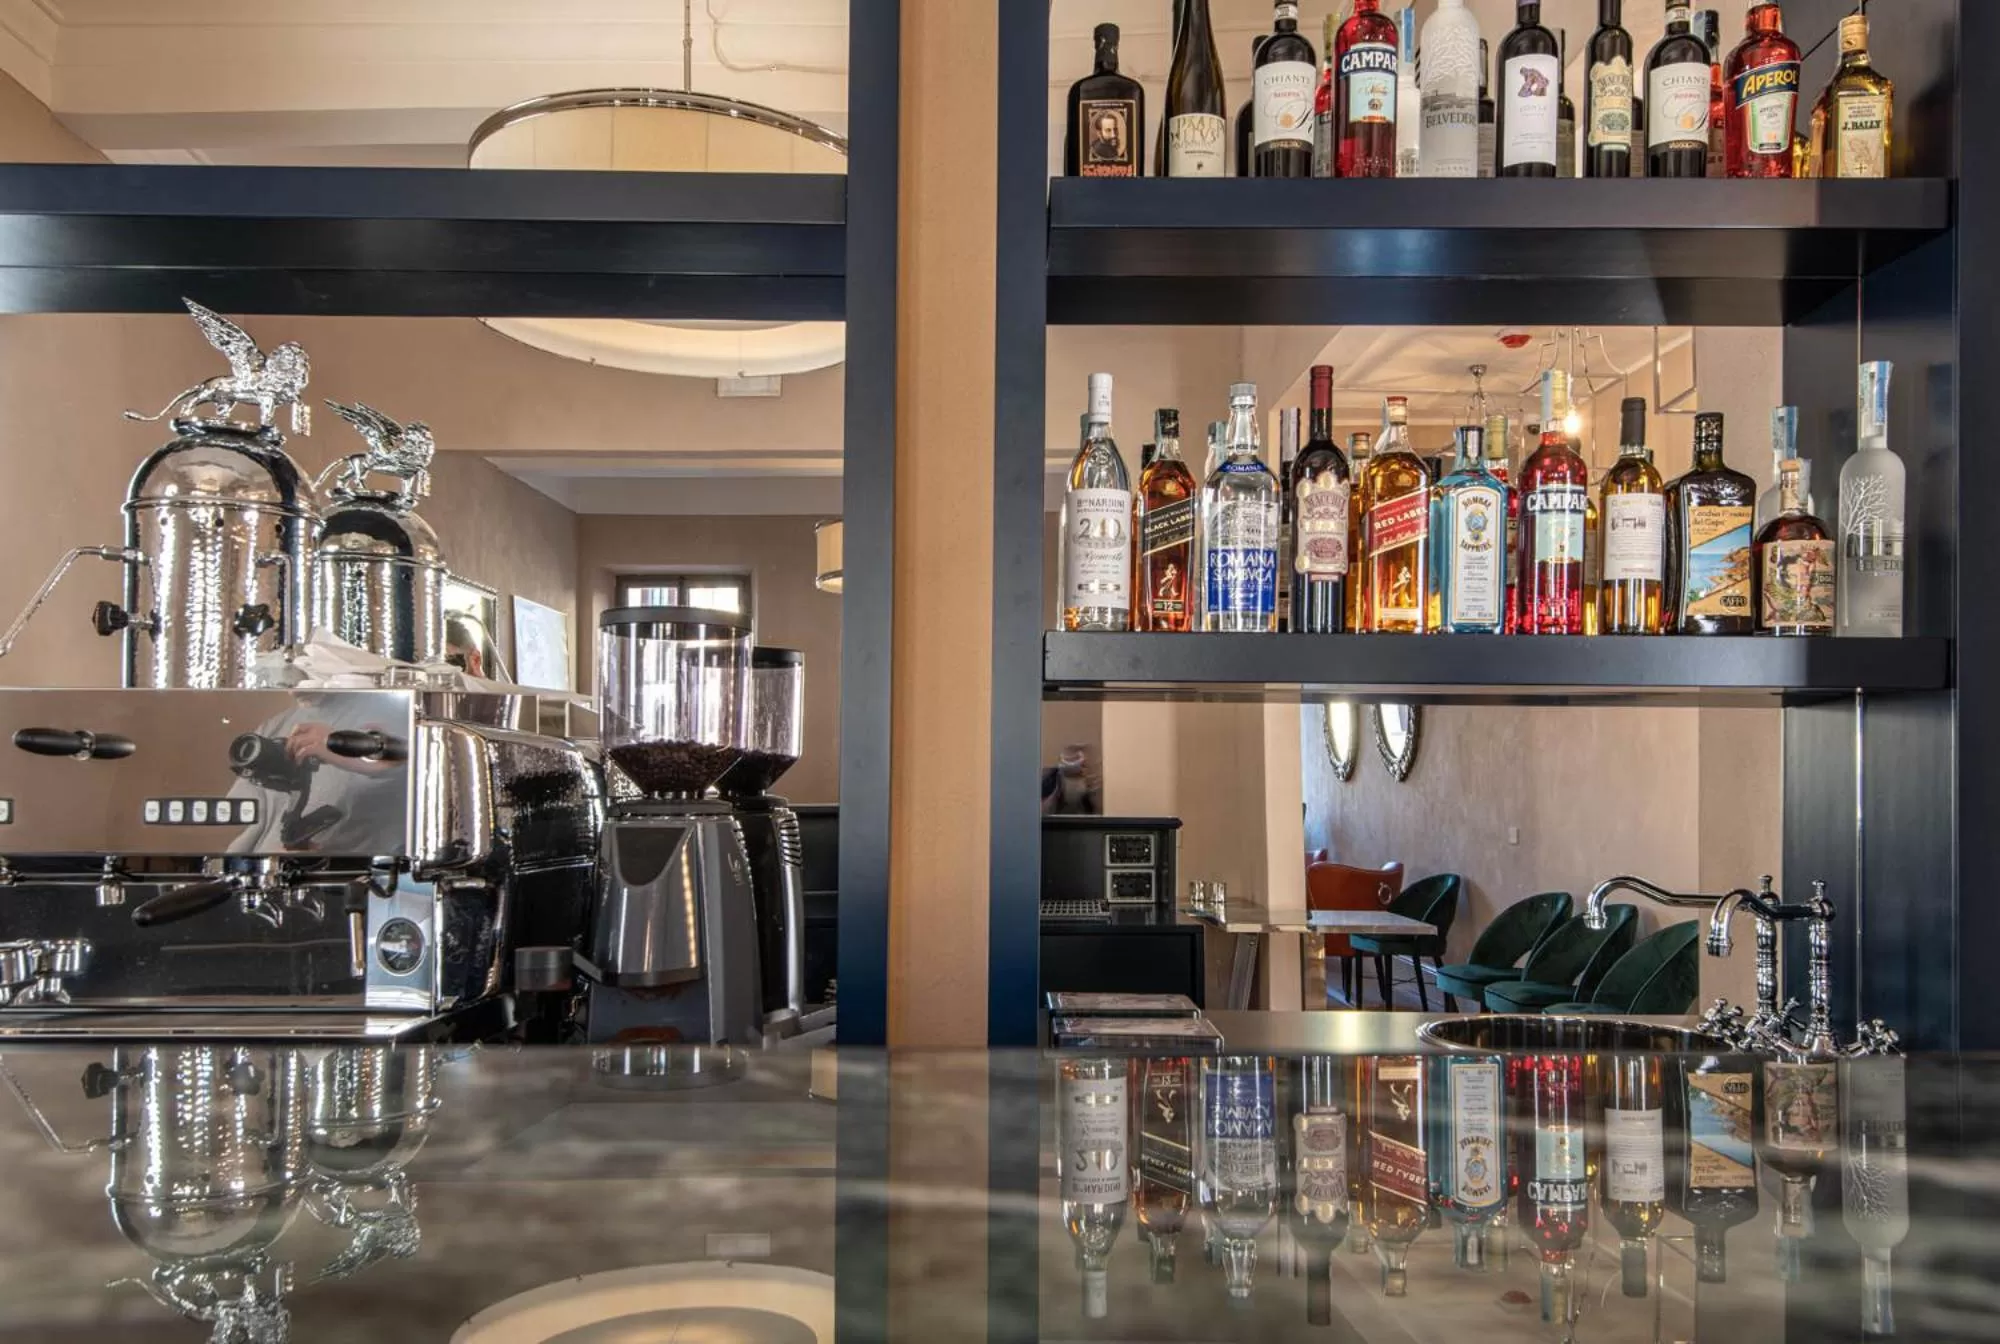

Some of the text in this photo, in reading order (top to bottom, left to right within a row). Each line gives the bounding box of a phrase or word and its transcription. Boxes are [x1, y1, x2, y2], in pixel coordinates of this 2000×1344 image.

[1743, 69, 1798, 98] APEROL
[1374, 517, 1395, 530] RED
[1397, 507, 1428, 522] LABEL
[1144, 522, 1169, 533] BLACK
[1210, 551, 1275, 568] ROMANA
[1163, 601, 1173, 611] 12
